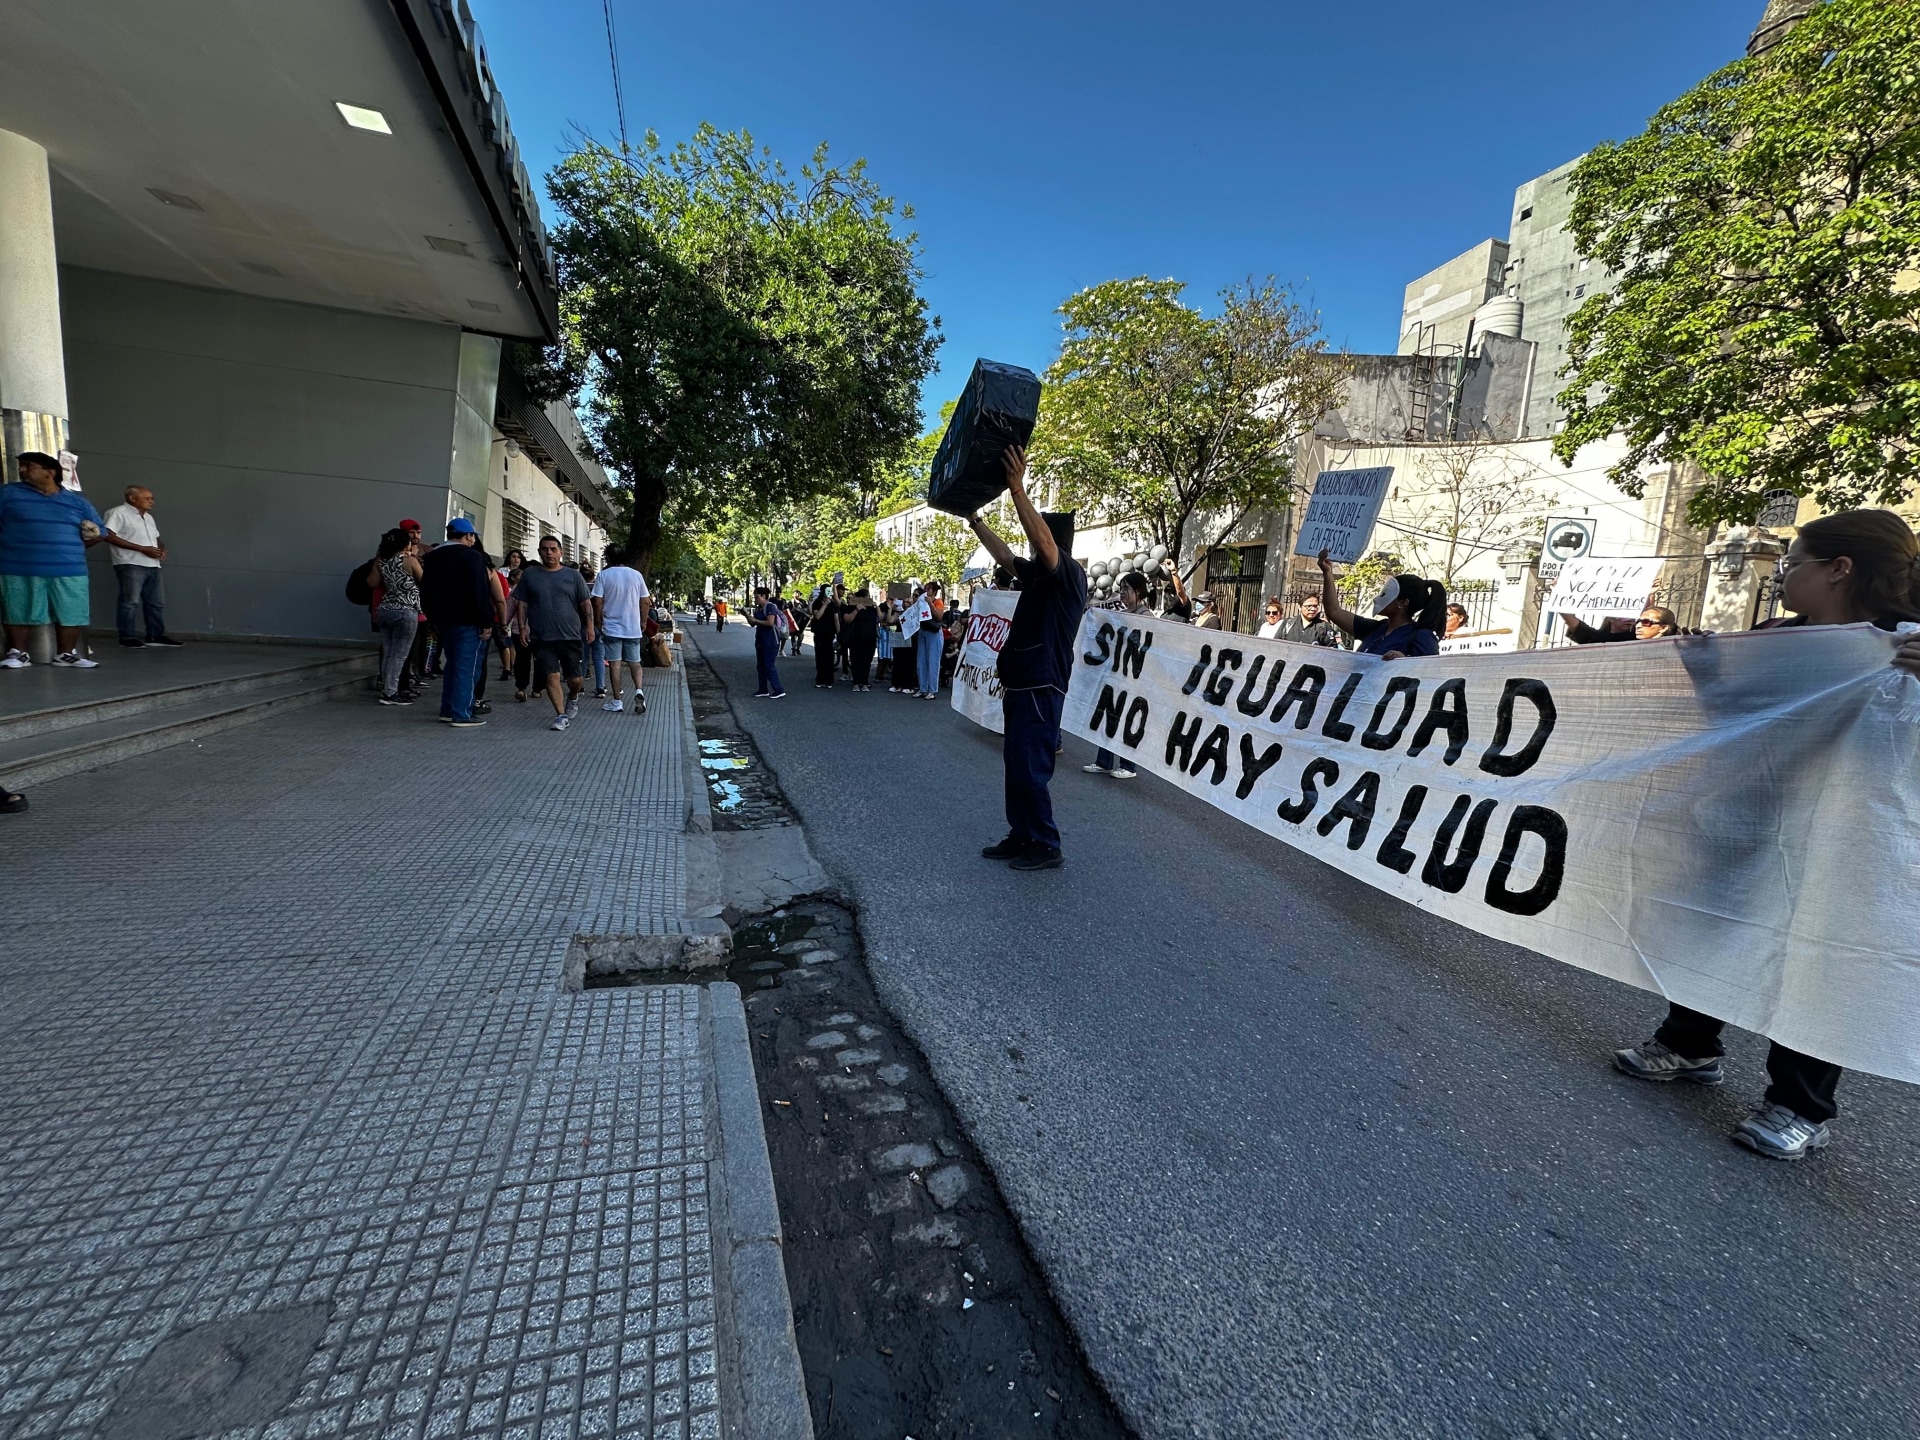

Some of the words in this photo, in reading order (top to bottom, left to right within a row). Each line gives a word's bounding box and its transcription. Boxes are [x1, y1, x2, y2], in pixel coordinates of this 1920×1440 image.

[1307, 501, 1319, 522] DEL
[1319, 501, 1340, 525] PAGO
[1336, 502, 1366, 529] DOBLE
[1309, 527, 1323, 550] EN
[1320, 528, 1350, 556] FIESTAS
[1569, 580, 1598, 593] VOZ
[1576, 593, 1646, 609] AMENAZADOS
[1083, 622, 1153, 680] SIN
[1182, 645, 1557, 778] IGUALDAD
[1090, 684, 1149, 749] NO
[1165, 711, 1282, 800] HAY
[1277, 757, 1568, 916] SALUD
